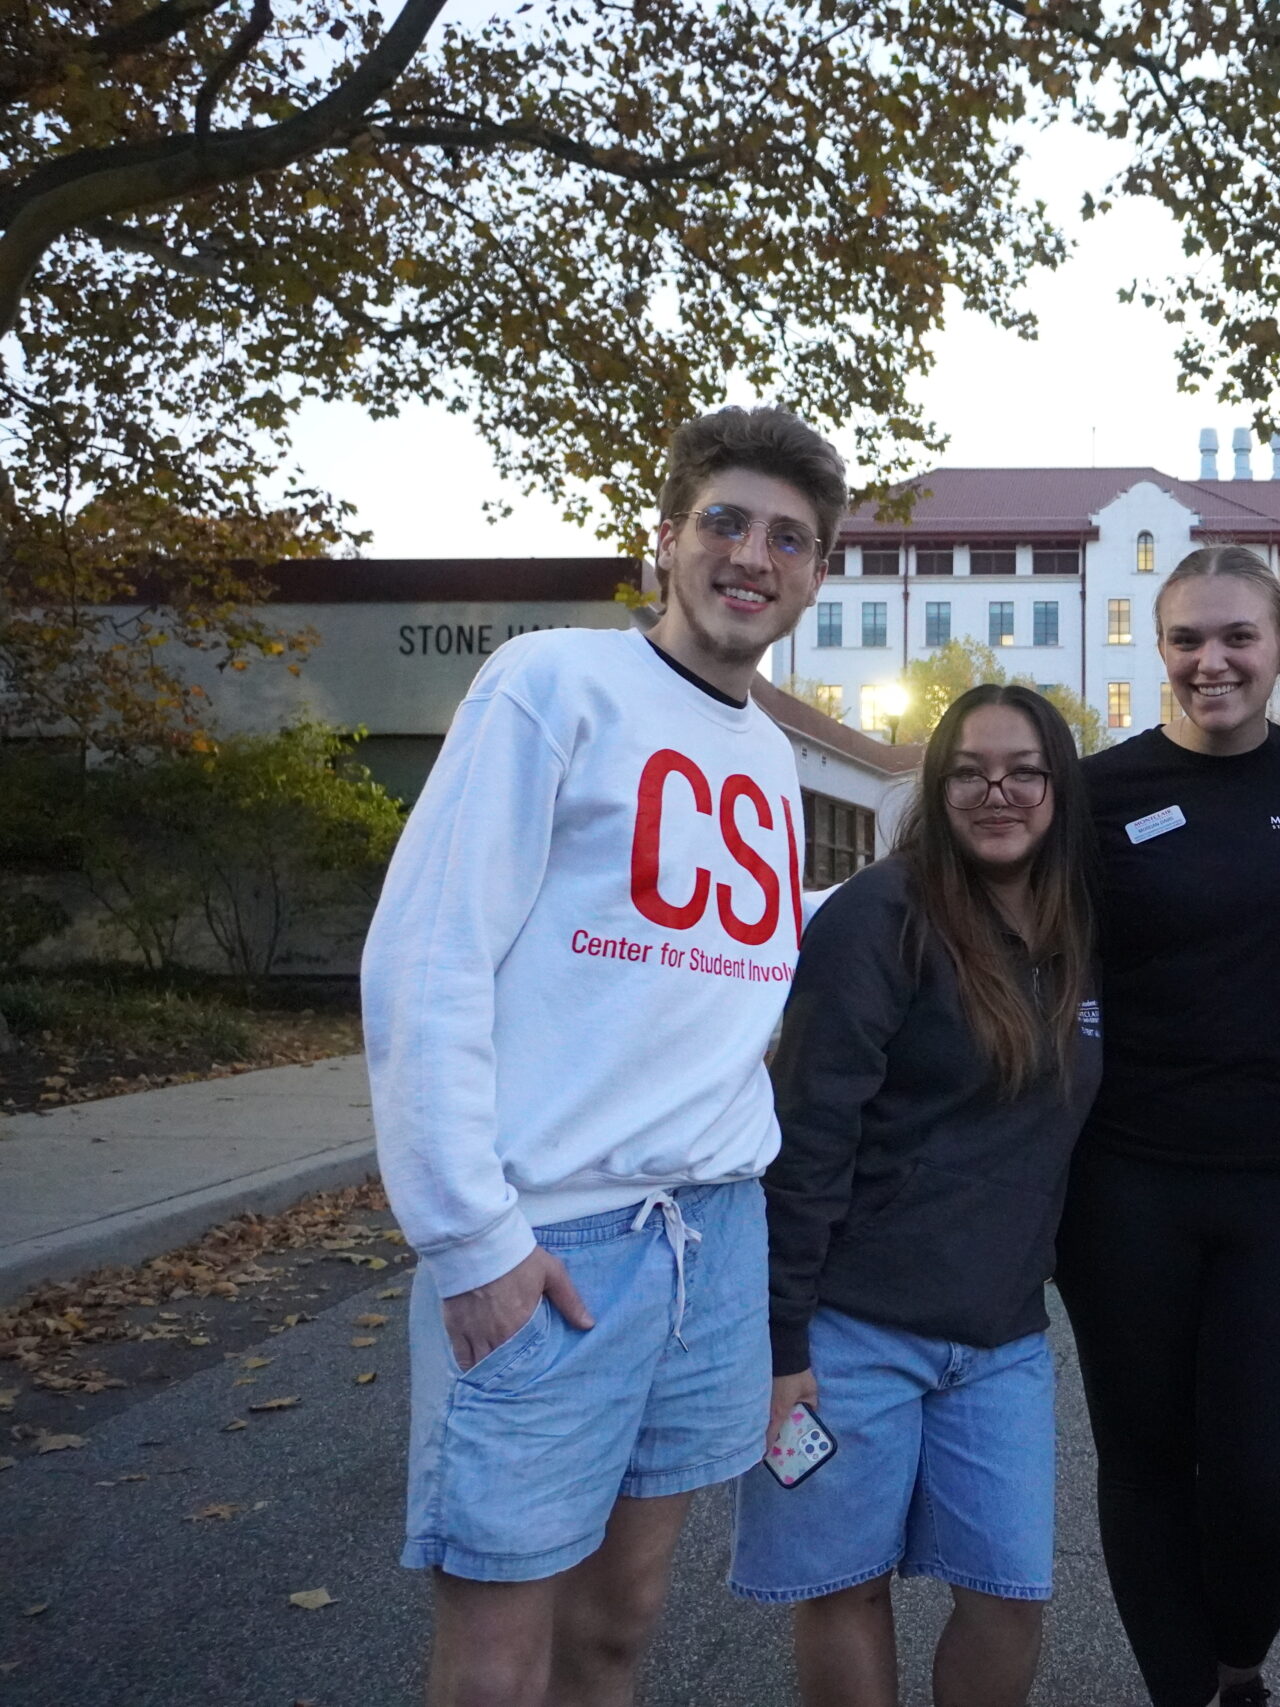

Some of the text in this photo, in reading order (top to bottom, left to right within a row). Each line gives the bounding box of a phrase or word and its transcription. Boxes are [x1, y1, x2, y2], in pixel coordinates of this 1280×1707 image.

[399, 624, 493, 655] STONE
[631, 748, 804, 951] CSI
[571, 929, 653, 963] Center
[661, 942, 685, 968] for
[689, 947, 745, 980] Student
